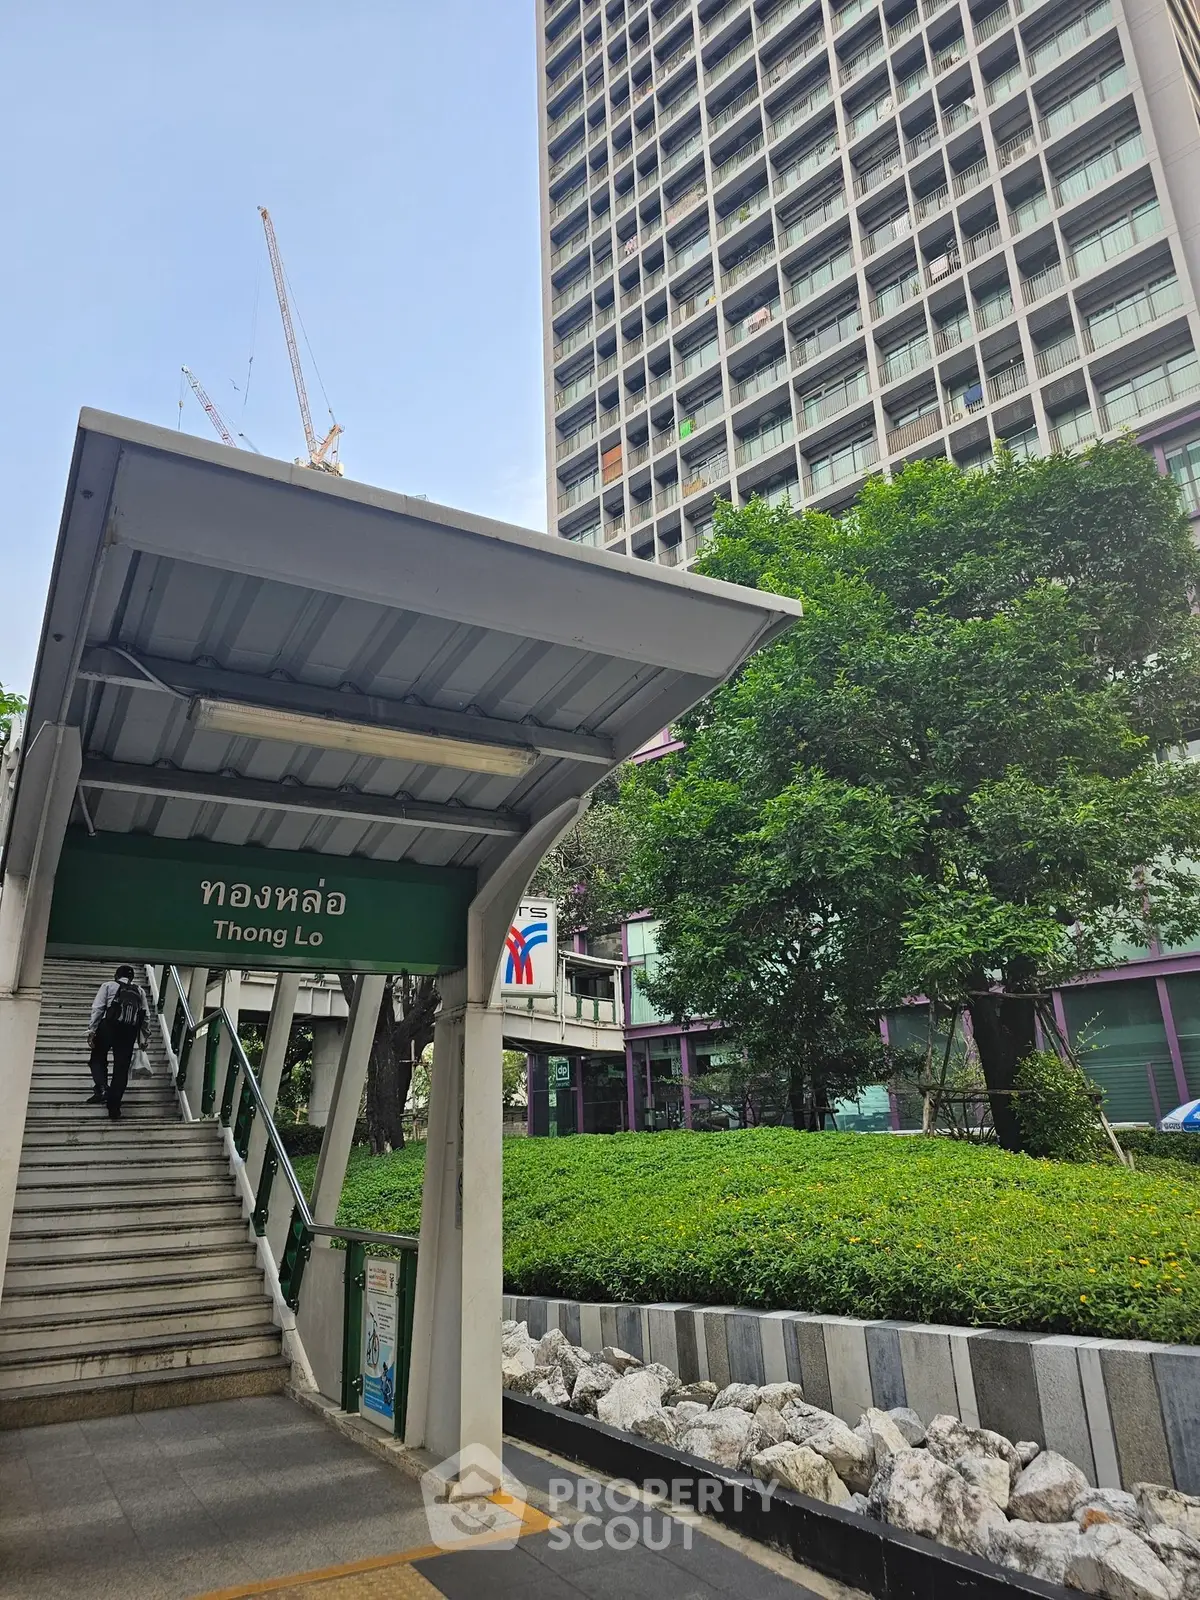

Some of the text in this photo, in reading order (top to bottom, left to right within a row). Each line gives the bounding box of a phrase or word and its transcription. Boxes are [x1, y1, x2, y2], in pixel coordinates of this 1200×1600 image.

[200, 877, 347, 916] ทองหล่อ
[518, 906, 548, 919] TS
[213, 919, 324, 949] Thong Lo
